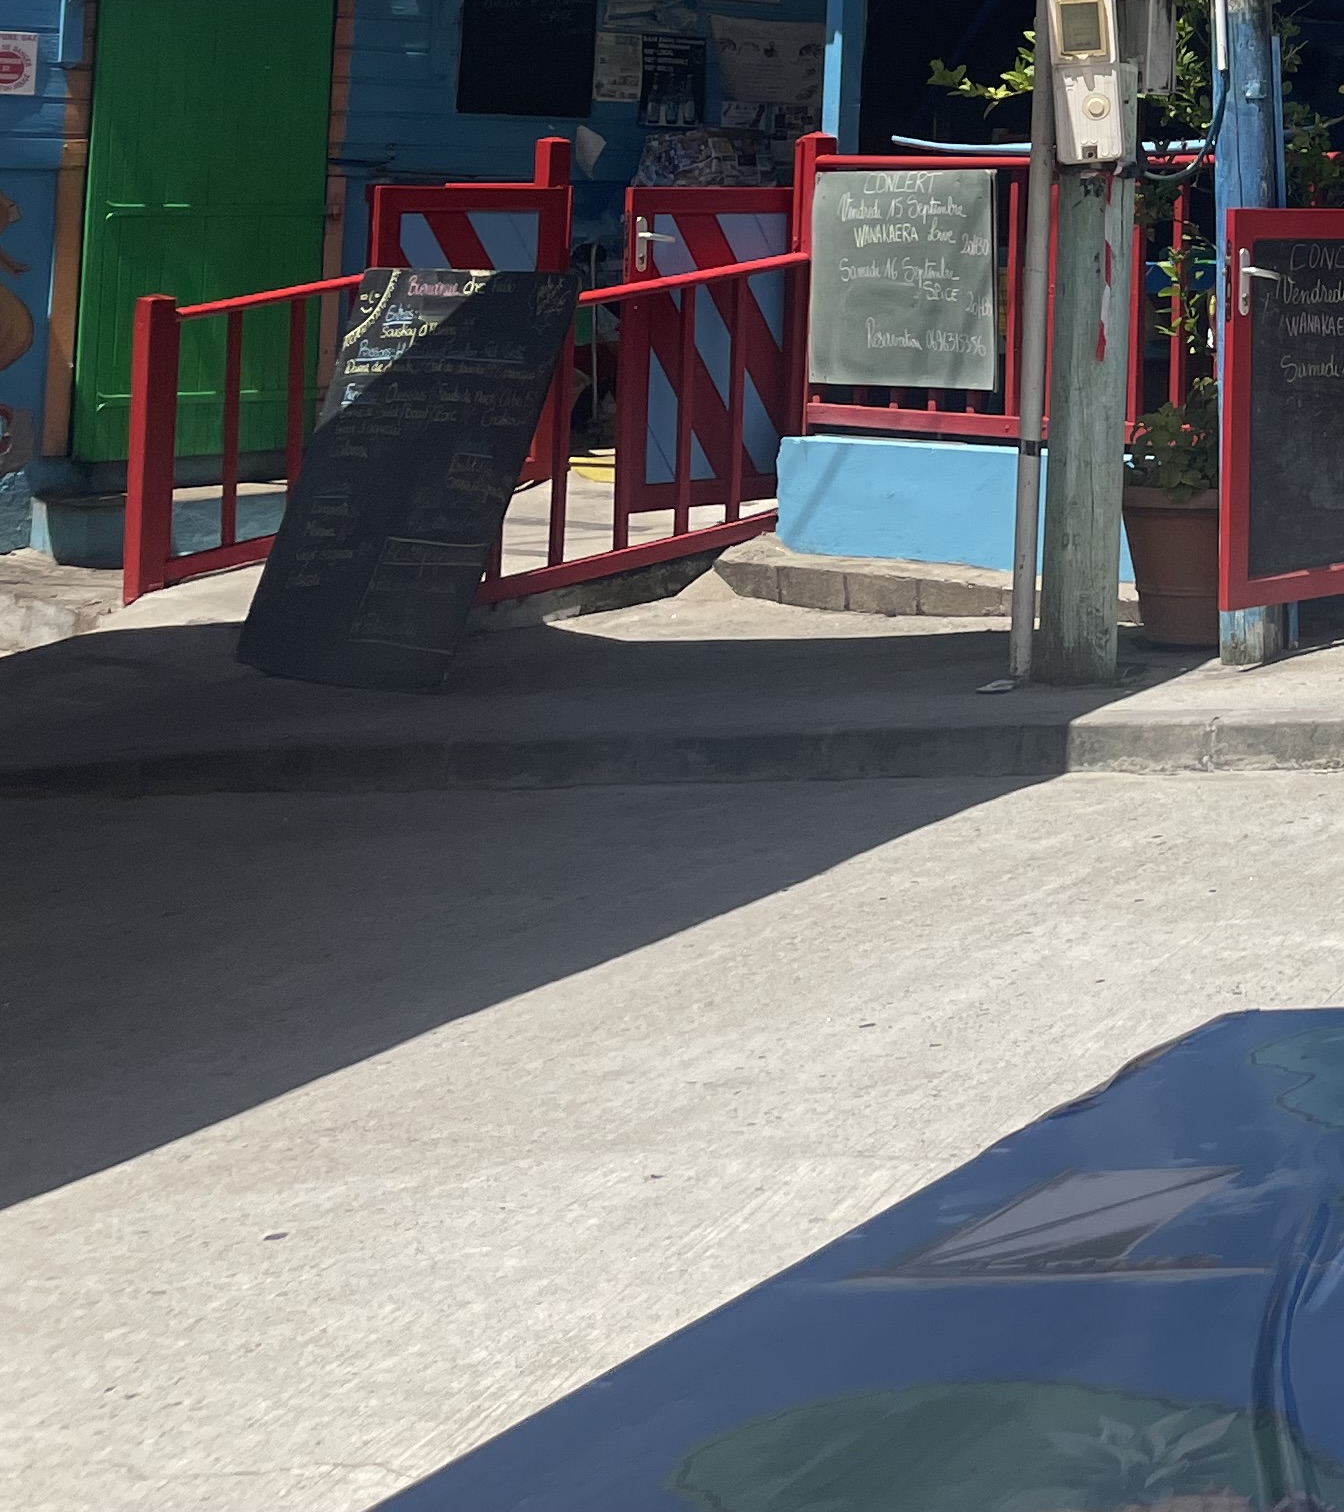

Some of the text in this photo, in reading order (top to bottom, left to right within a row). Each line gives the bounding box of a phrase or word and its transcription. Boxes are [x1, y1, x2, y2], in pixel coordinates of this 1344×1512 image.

[863, 172, 944, 193] CONCERT
[886, 196, 903, 220] 15
[884, 257, 897, 280] 16
[923, 281, 960, 301] SPICE
[1280, 354, 1340, 383] Samedi
